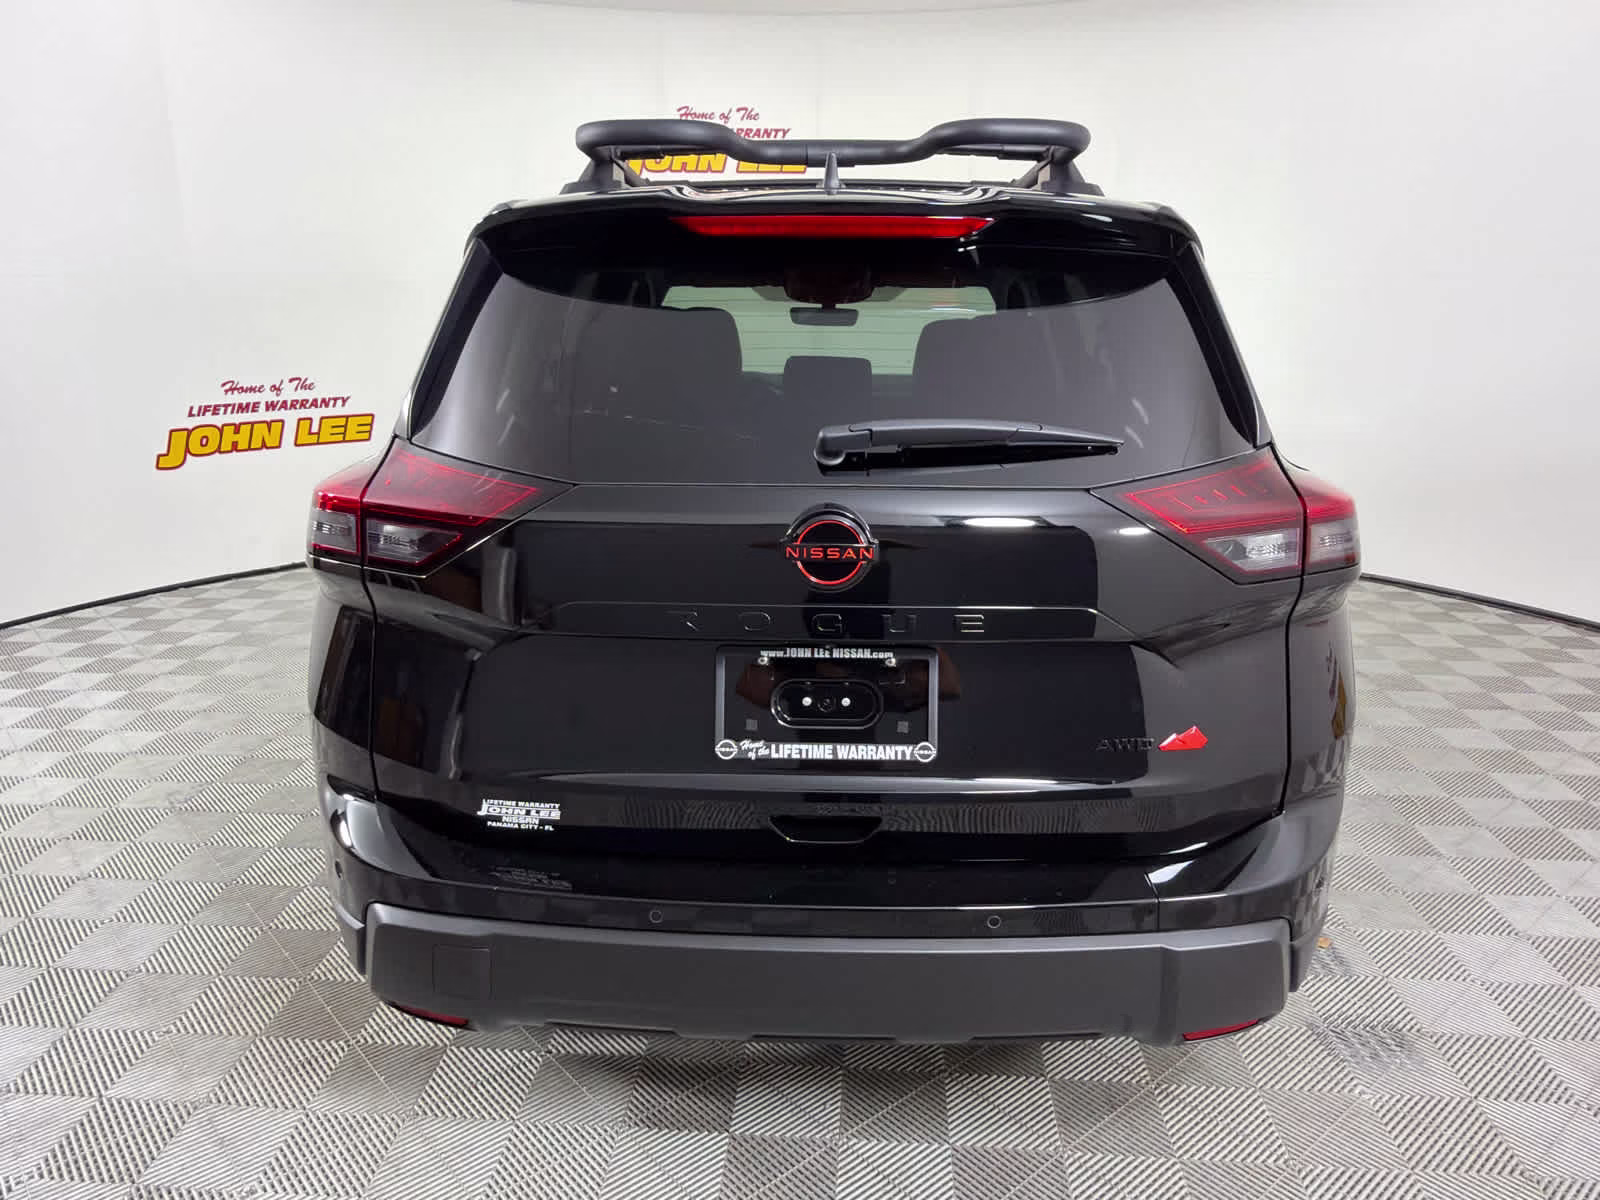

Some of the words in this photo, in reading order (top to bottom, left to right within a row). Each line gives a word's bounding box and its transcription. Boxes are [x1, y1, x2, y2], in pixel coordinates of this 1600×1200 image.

[676, 105, 715, 121] Home
[719, 107, 732, 124] of
[736, 106, 760, 121] The
[735, 127, 791, 139] RRANTY
[221, 380, 265, 395] Home
[269, 379, 284, 396] of
[288, 376, 315, 392] The
[187, 401, 260, 418] LIFETIME
[264, 395, 351, 413] WARRANTY
[156, 418, 285, 471] JOHN
[294, 413, 375, 447] LEE
[785, 547, 874, 560] NISSAN
[666, 610, 986, 633] ROGUE
[760, 648, 812, 658] www.JOHN
[814, 648, 831, 658] LEE
[739, 739, 766, 752] Home
[770, 744, 833, 759] LIFETIME
[837, 745, 913, 760] WARRANTY
[477, 804, 526, 816] JOHN
[518, 801, 560, 809] WARRANTY
[487, 821, 519, 829] PANAMA
[502, 816, 539, 824] NISSAN
